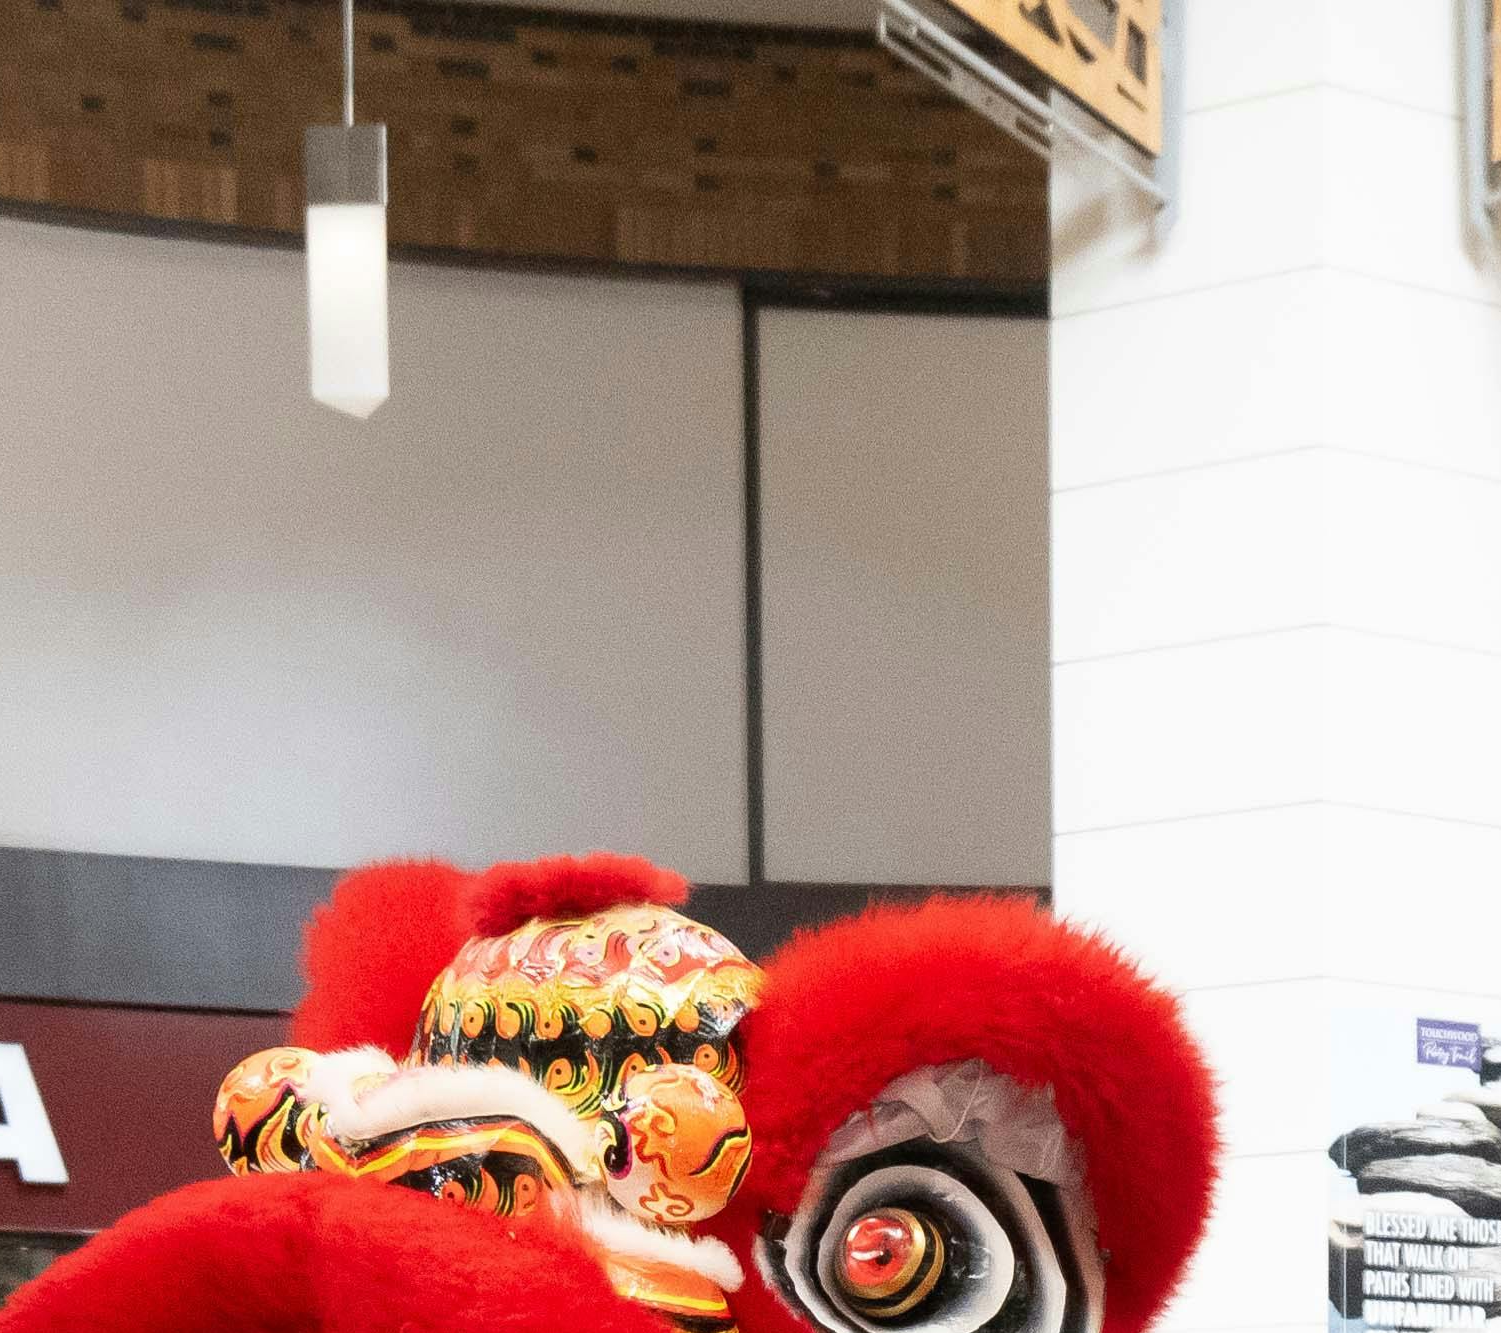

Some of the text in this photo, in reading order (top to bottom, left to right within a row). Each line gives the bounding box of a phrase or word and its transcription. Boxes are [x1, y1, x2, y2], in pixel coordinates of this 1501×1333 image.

[1420, 1027, 1478, 1042] TOUCHWOOD
[1364, 1212, 1428, 1239] BLESSED
[1429, 1216, 1459, 1242] ARE
[1364, 1241, 1470, 1271] THAT WALK ON
[1363, 1270, 1495, 1303] PATHS LINED WITH
[1363, 1300, 1487, 1328] UNFAMILIAR
